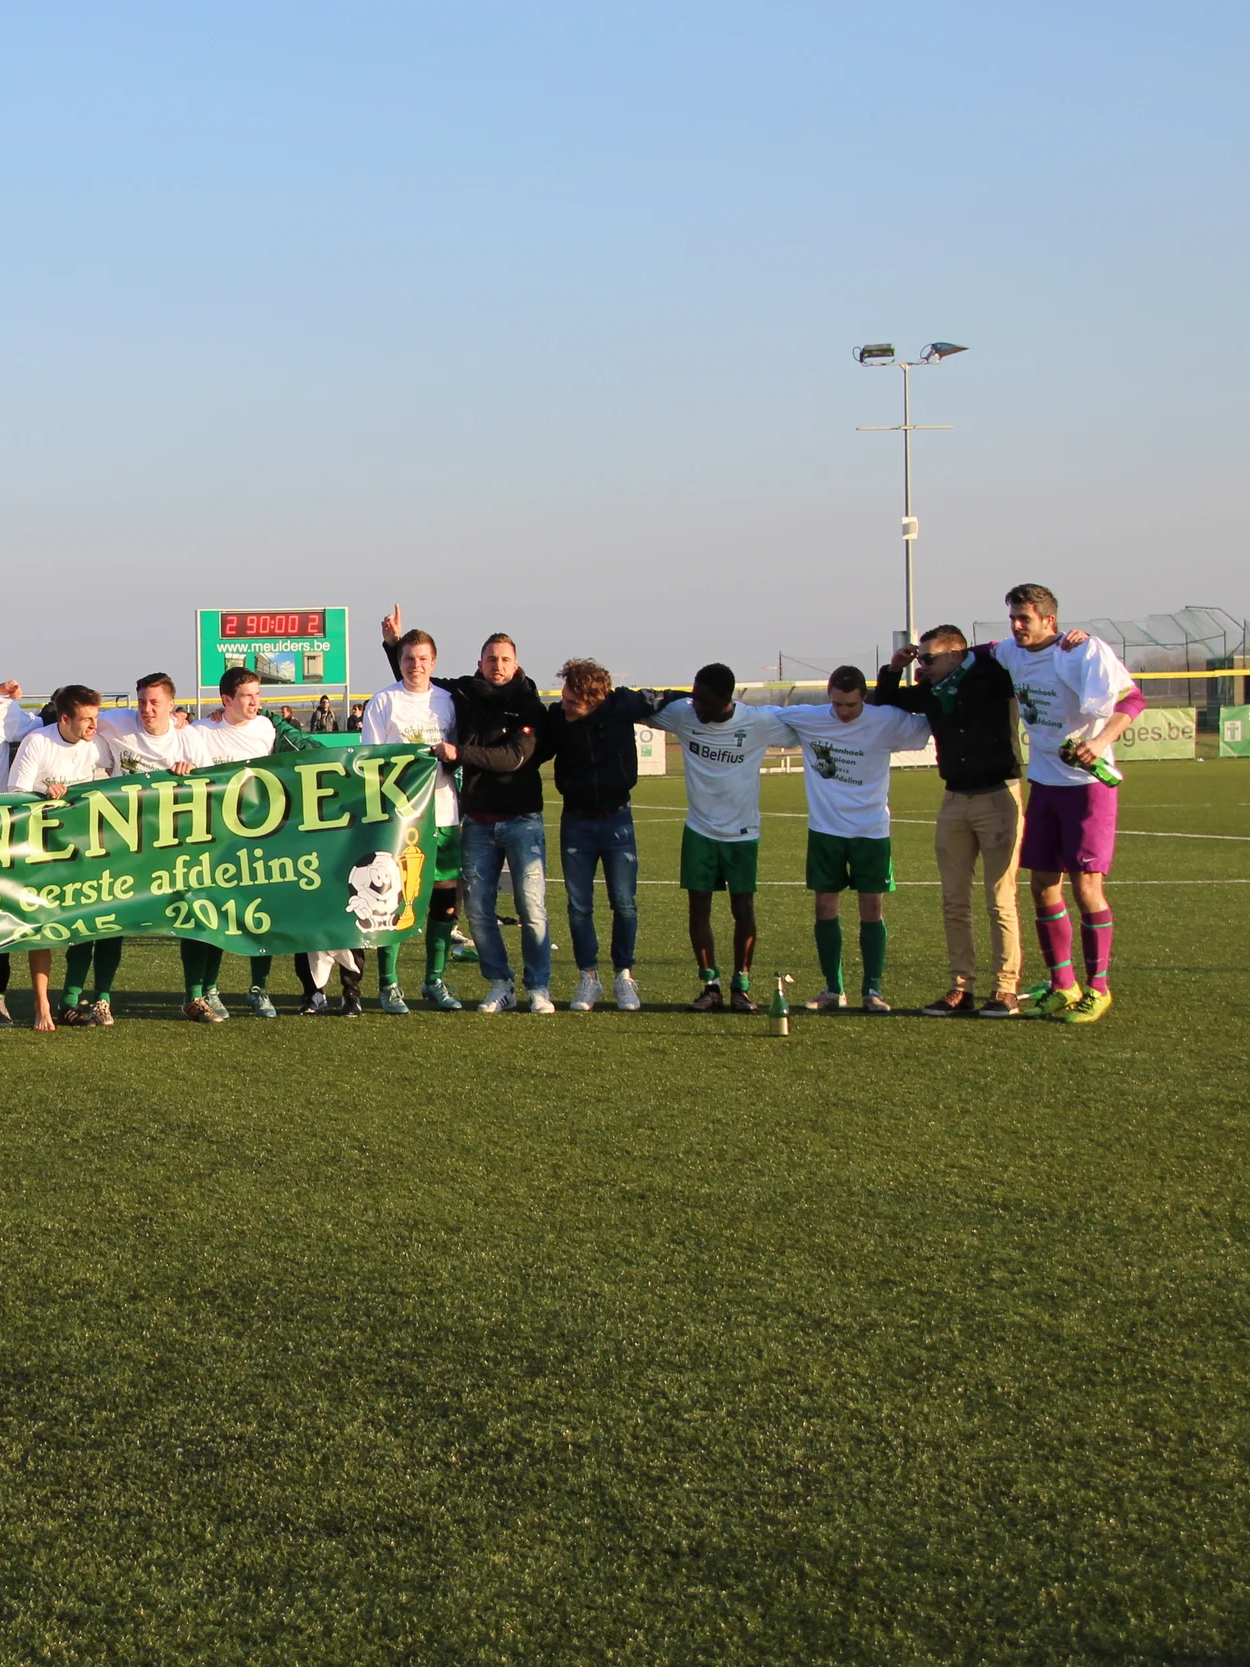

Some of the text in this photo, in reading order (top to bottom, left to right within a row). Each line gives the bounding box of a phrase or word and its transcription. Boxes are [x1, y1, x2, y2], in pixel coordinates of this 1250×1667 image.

[225, 614, 319, 635] 2 90:00 2
[216, 640, 331, 653] www.meulders.be
[701, 746, 745, 764] Belfius
[18, 868, 135, 912] eerste
[150, 847, 321, 895] afdeling
[12, 913, 123, 942] 2015
[164, 896, 272, 936] 2016
